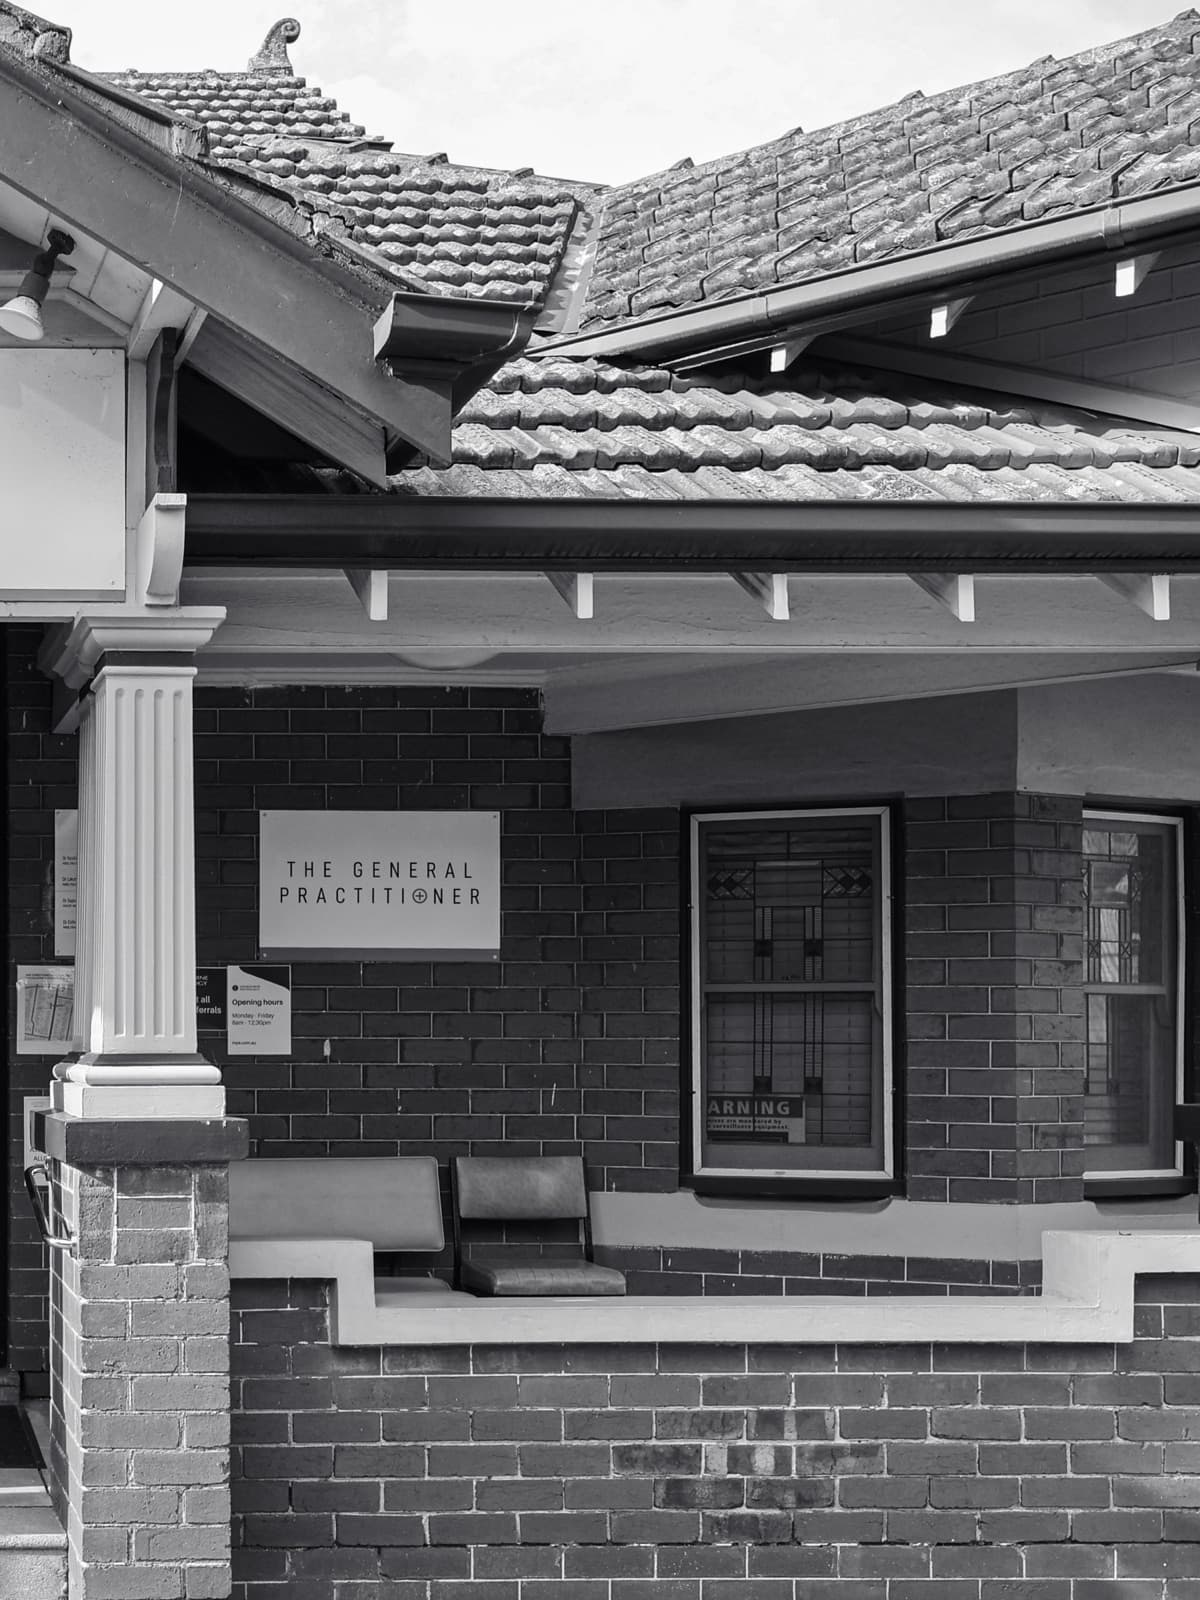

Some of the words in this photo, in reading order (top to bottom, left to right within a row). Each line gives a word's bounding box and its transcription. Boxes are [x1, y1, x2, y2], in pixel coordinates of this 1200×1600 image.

[287, 860, 332, 878] THE
[353, 861, 473, 879] GENERAL
[279, 886, 481, 905] PRACTITIONER
[232, 998, 262, 1007] Opening
[263, 998, 283, 1006] hours
[197, 1005, 222, 1015] ferrals
[232, 1012, 254, 1020] Monday
[257, 1012, 275, 1020] Friday
[708, 1100, 790, 1115] ARNING
